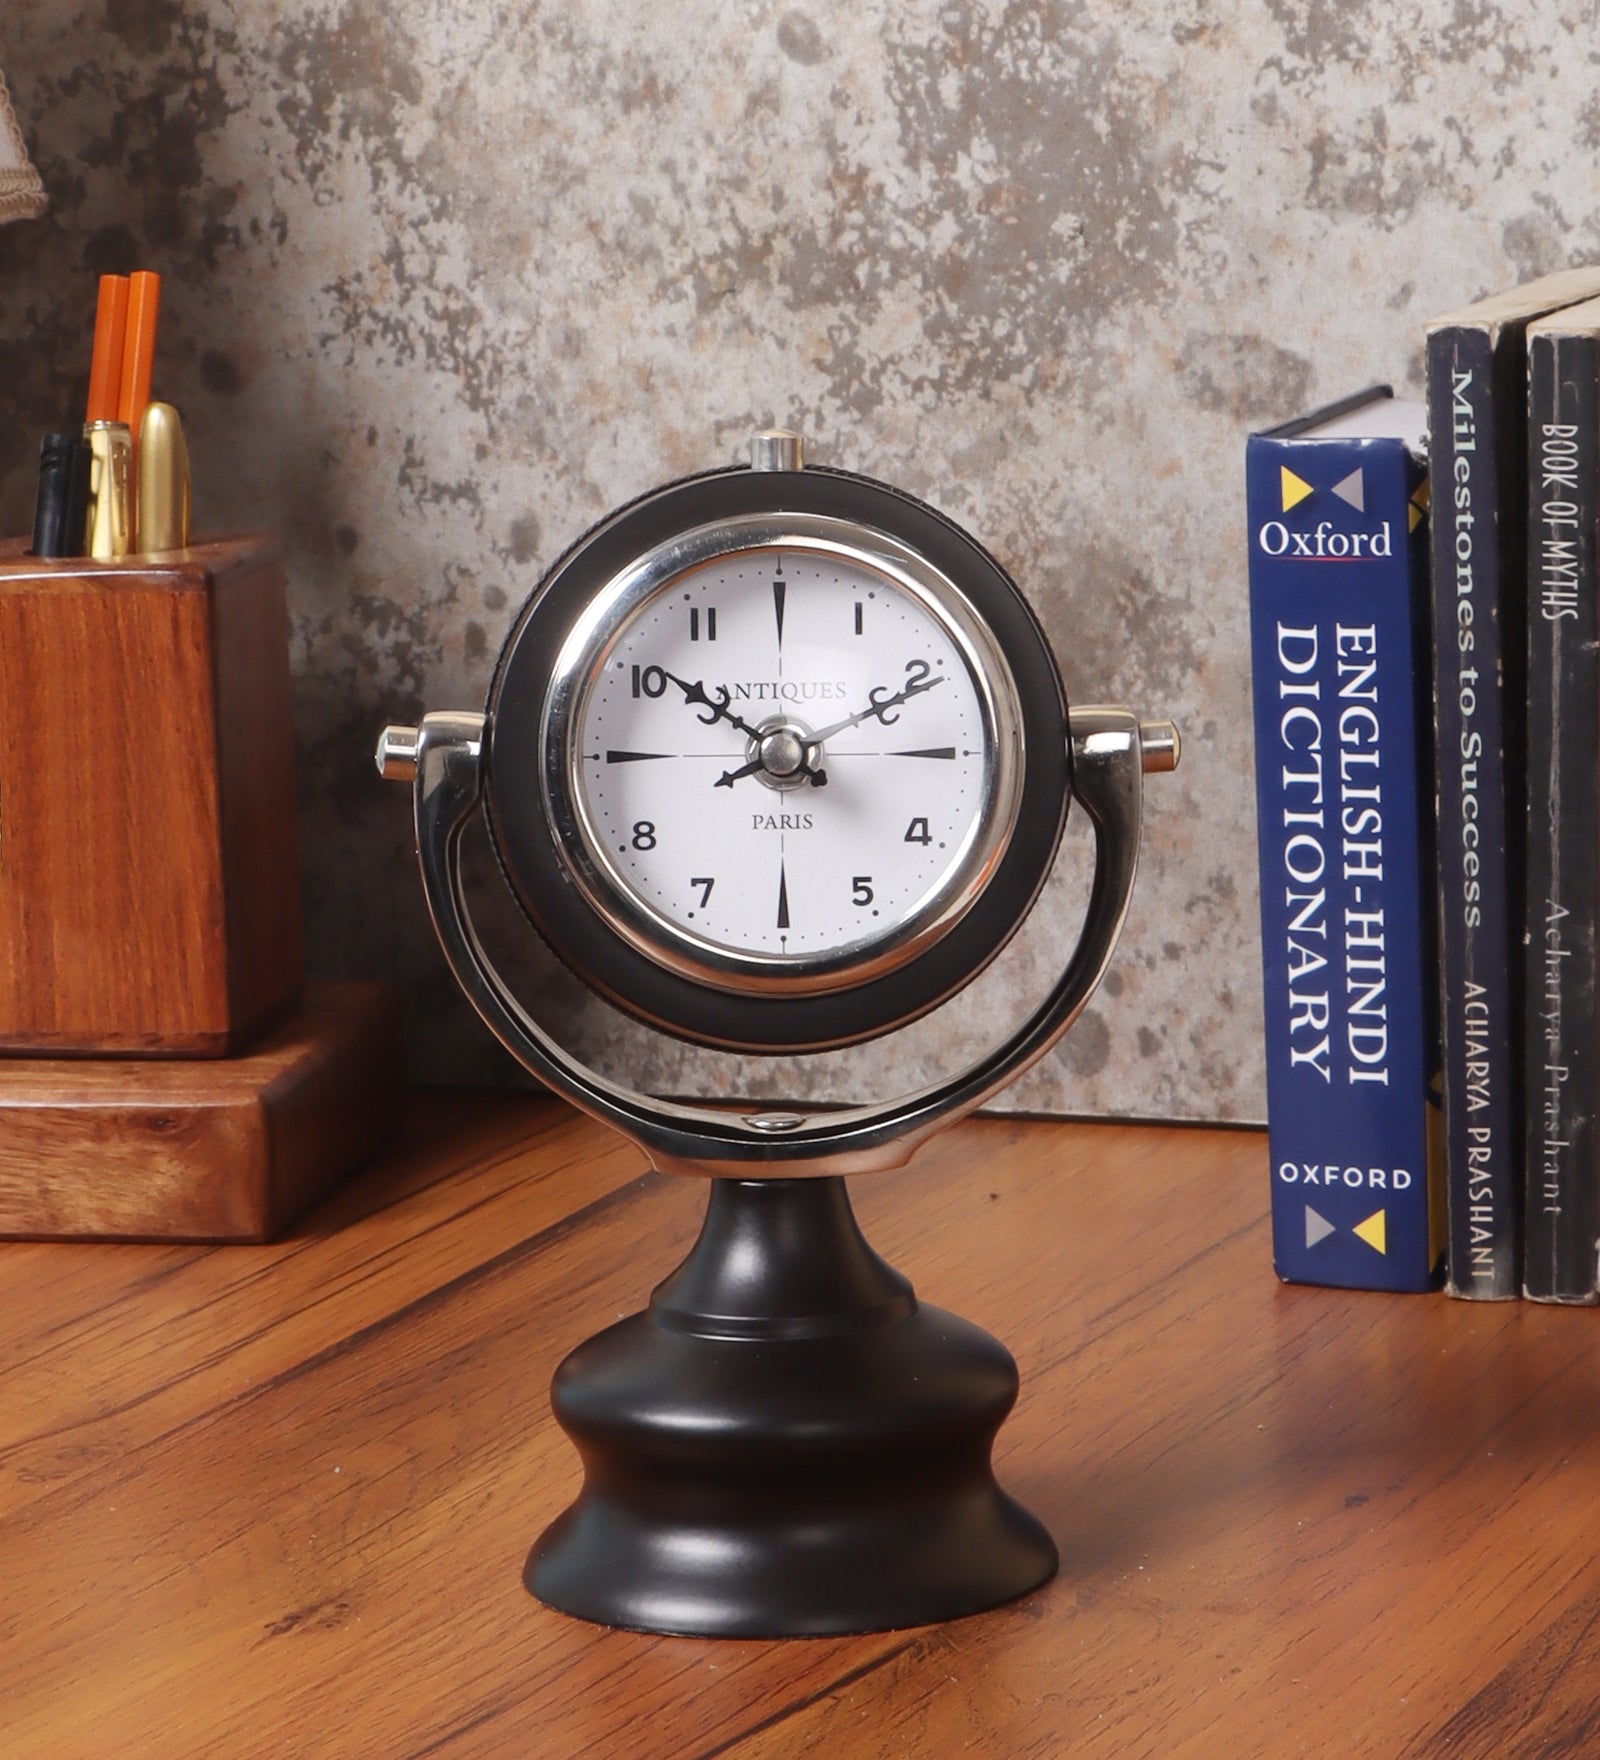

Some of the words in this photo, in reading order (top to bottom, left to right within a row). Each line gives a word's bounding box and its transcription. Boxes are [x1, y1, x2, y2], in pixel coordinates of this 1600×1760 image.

[1541, 423, 1579, 489] BOOK
[1451, 368, 1477, 653] Milestones
[1541, 501, 1579, 529] OF
[1259, 520, 1393, 558] Oxford
[1541, 540, 1579, 621] MYTHS
[690, 607, 717, 641] 11
[855, 602, 863, 635] 1
[631, 665, 668, 698] 10
[716, 681, 847, 704] ANTIQUES
[904, 659, 931, 694] 2
[1458, 669, 1479, 718] to
[631, 821, 657, 851] 8
[752, 813, 814, 830] PARIS
[904, 817, 933, 847] 4
[1459, 731, 1482, 929] Success
[1276, 620, 1331, 1085] DICTIONARY
[1335, 622, 1389, 1086] ENGLISH-HINDI
[690, 877, 715, 908] 7
[851, 876, 874, 906] 5
[1540, 898, 1571, 1043] Acharya
[1463, 980, 1492, 1113] ACHARYA
[1543, 1064, 1570, 1215] Prashant
[1279, 1162, 1412, 1190] OXFORD
[1467, 1127, 1496, 1281] PRASHANT
